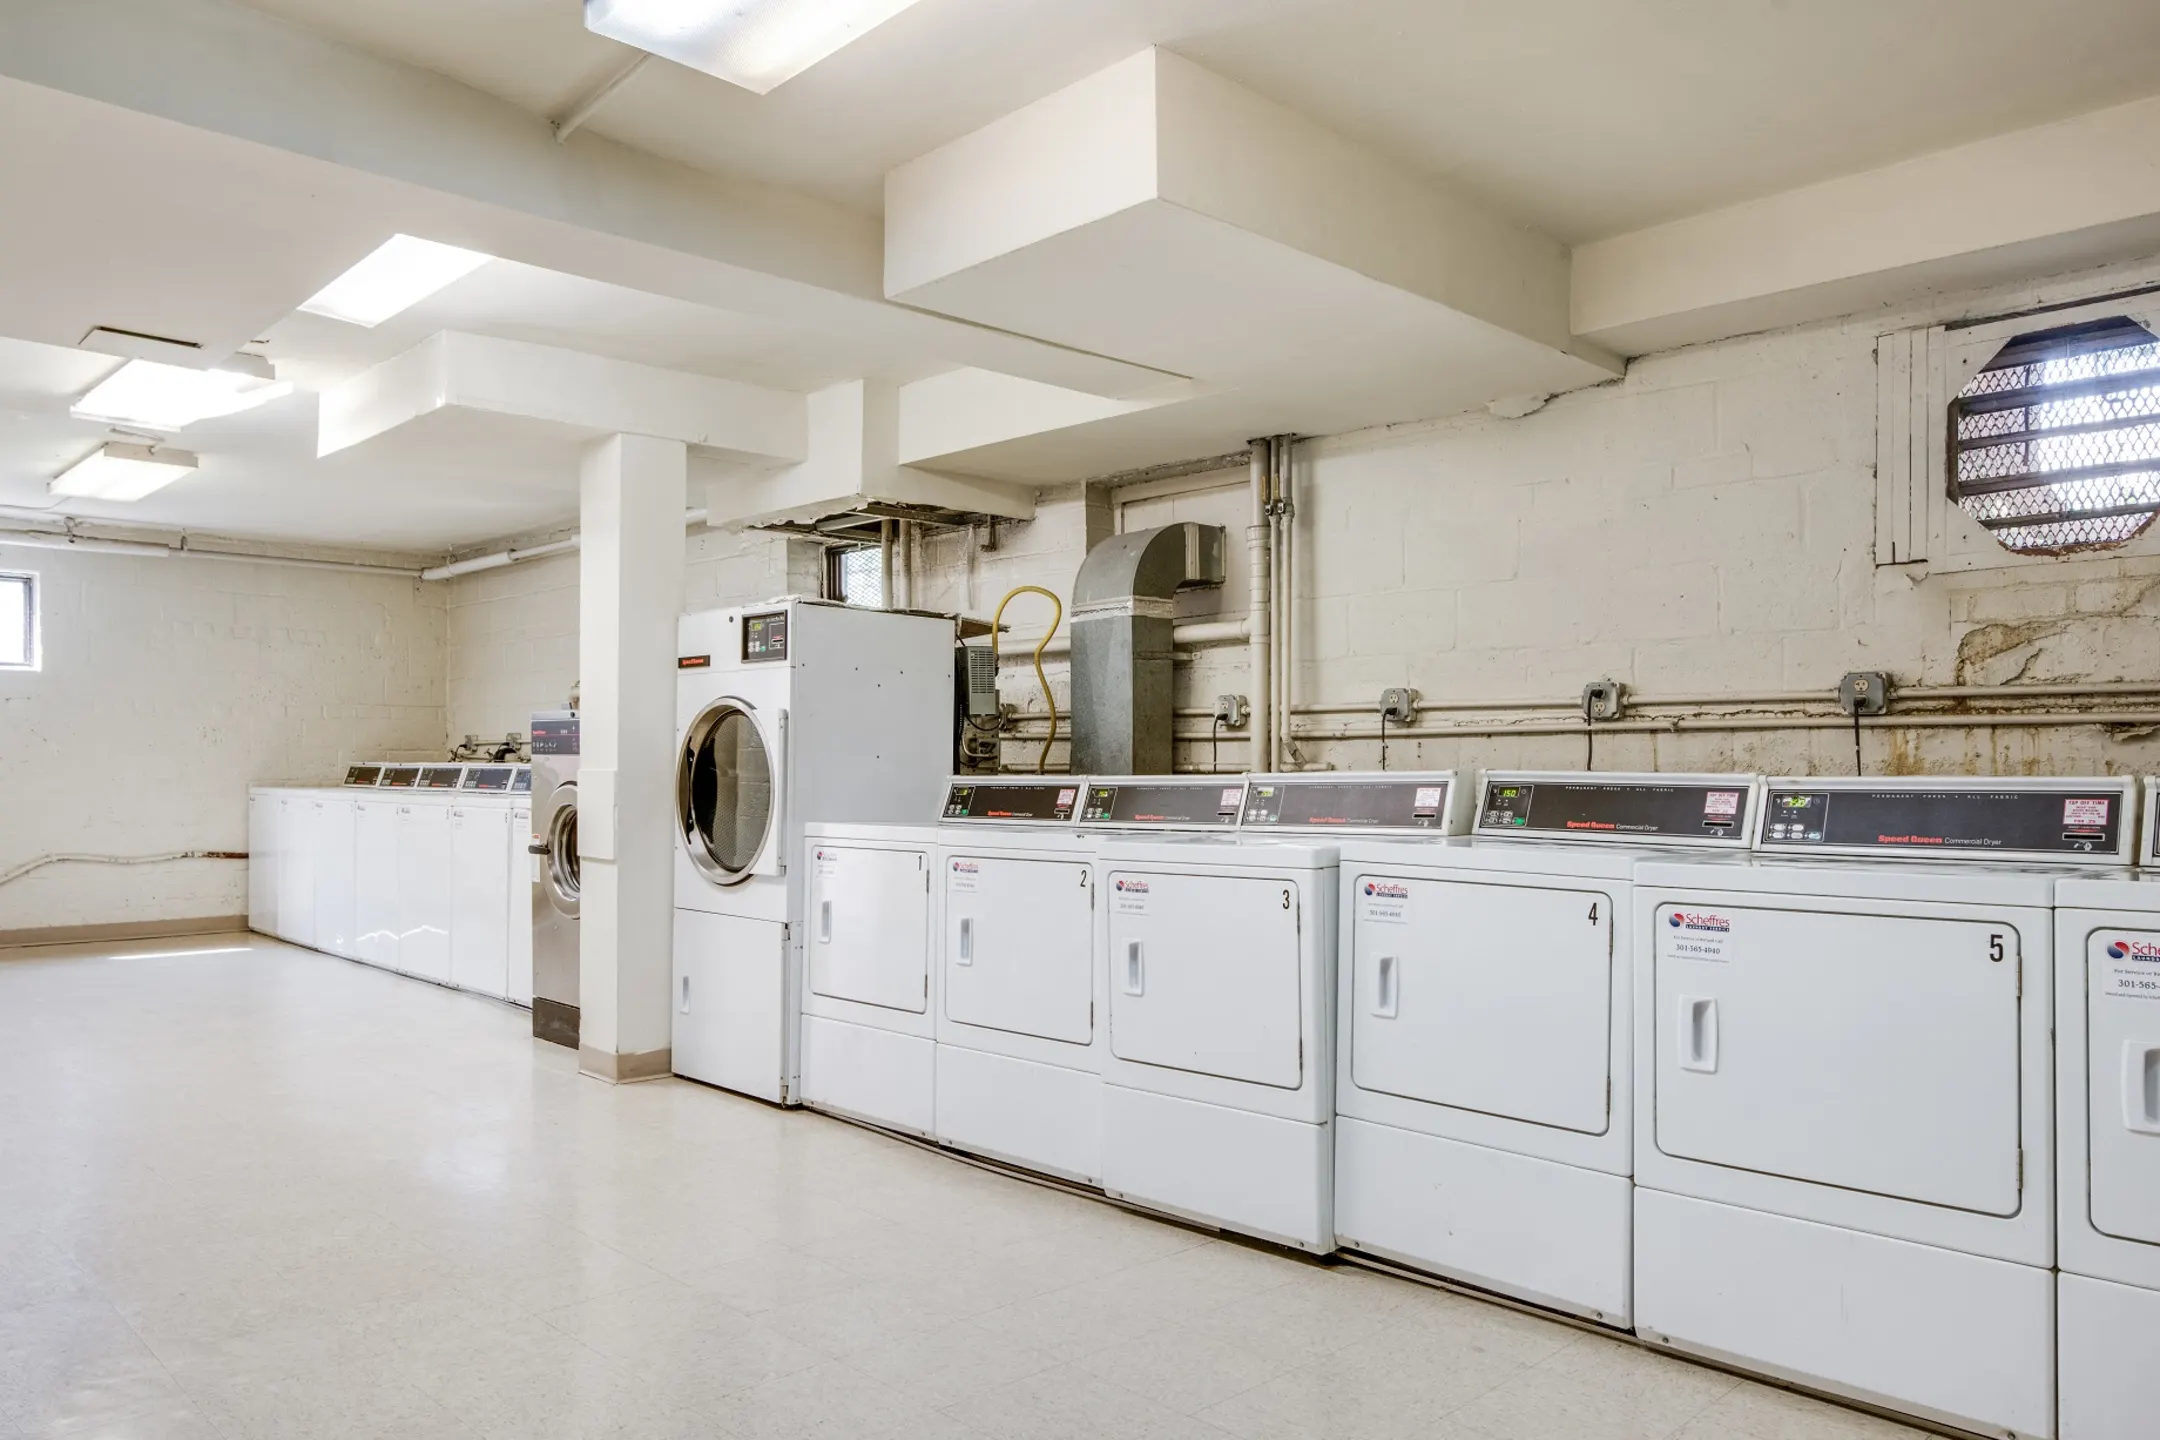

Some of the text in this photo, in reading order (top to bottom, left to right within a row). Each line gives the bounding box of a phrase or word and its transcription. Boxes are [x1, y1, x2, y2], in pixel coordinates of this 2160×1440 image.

[1503, 789, 1516, 797] 150
[1567, 821, 1590, 829] Speed
[1591, 821, 1615, 829] Queen
[1878, 834, 2002, 846] Speed Queen Commercial Dryer
[1080, 869, 1086, 888] 2
[1376, 883, 1408, 895] Scheffres
[1282, 889, 1290, 910] 3
[1588, 902, 1598, 926] 4
[1686, 913, 1730, 928] Scheffres
[1990, 934, 2003, 962] 5
